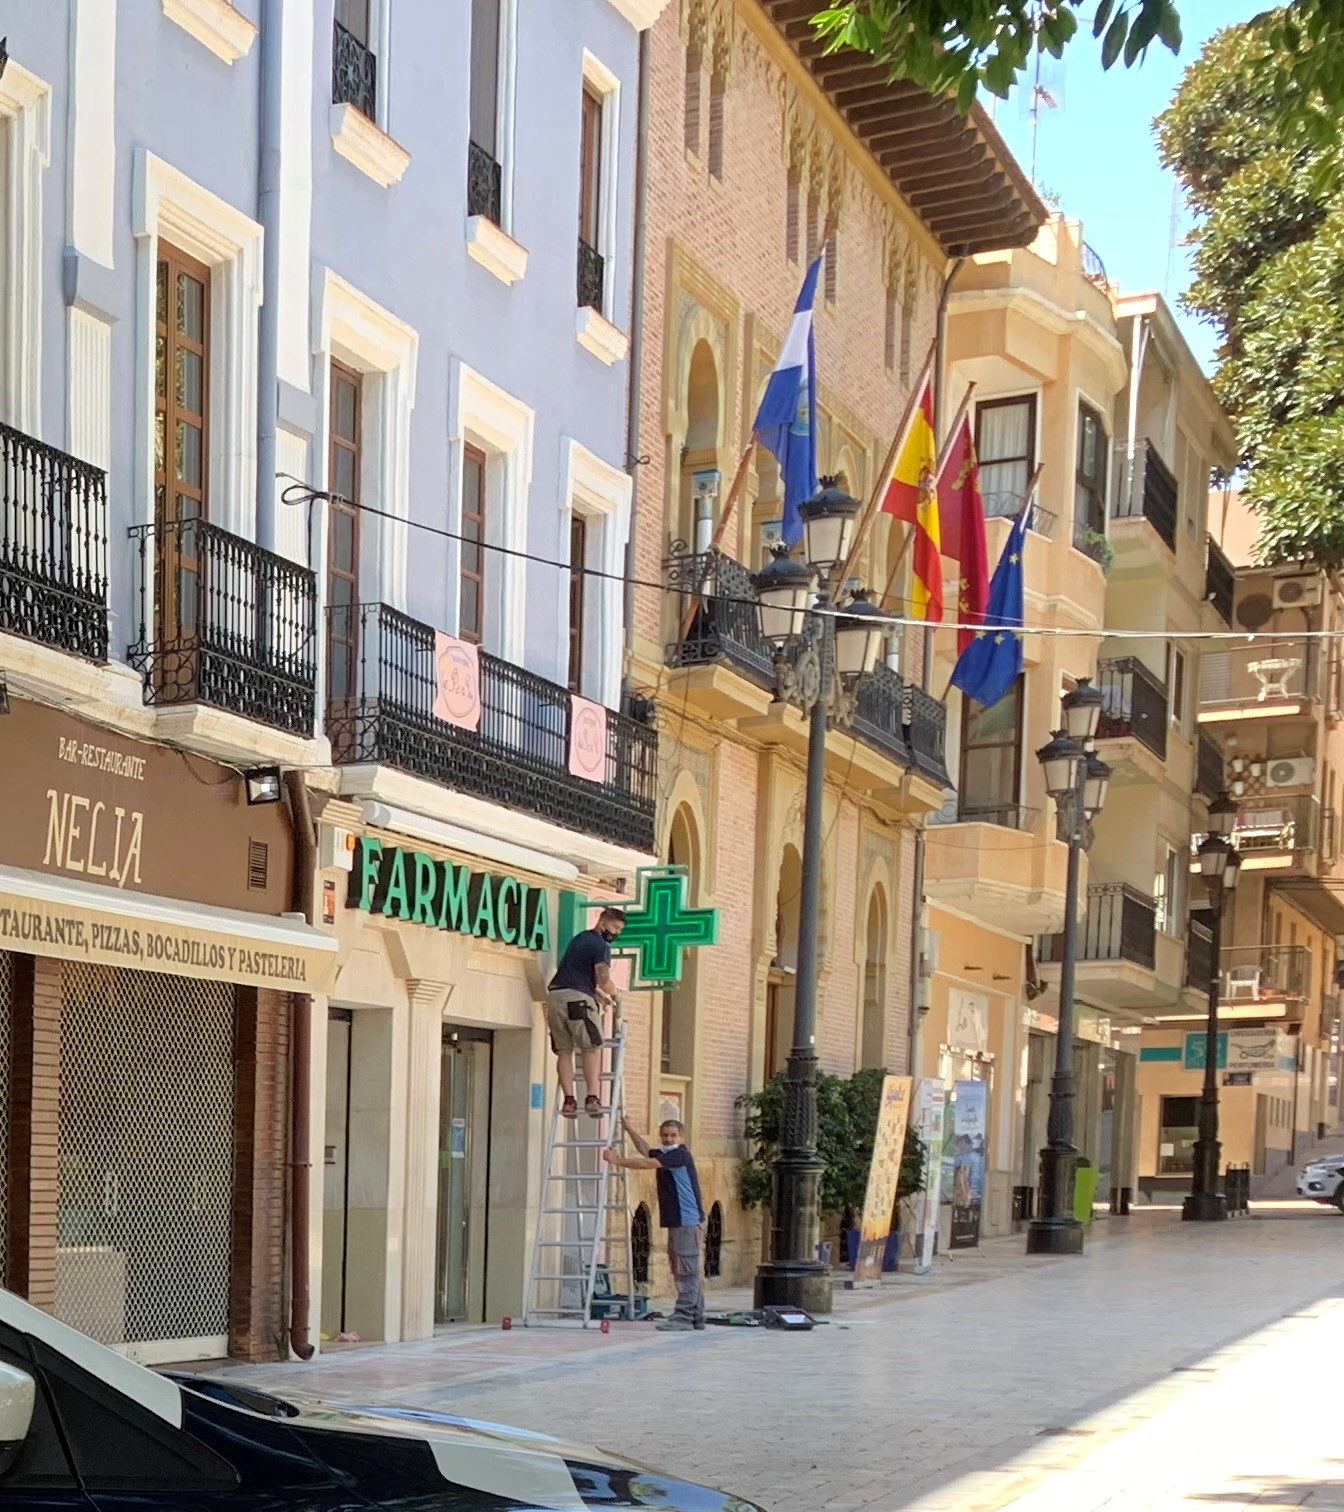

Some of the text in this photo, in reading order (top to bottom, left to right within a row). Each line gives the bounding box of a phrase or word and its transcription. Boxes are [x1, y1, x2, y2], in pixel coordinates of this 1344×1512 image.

[58, 736, 146, 781] BAR-RESTAURANTE
[43, 789, 143, 888] NELIA
[354, 837, 551, 951] FARMACIA
[91, 922, 144, 961] PIZZAS,
[147, 932, 226, 970] BOCADILLOS
[227, 947, 239, 971] Y
[239, 953, 306, 982] PASTELERIA
